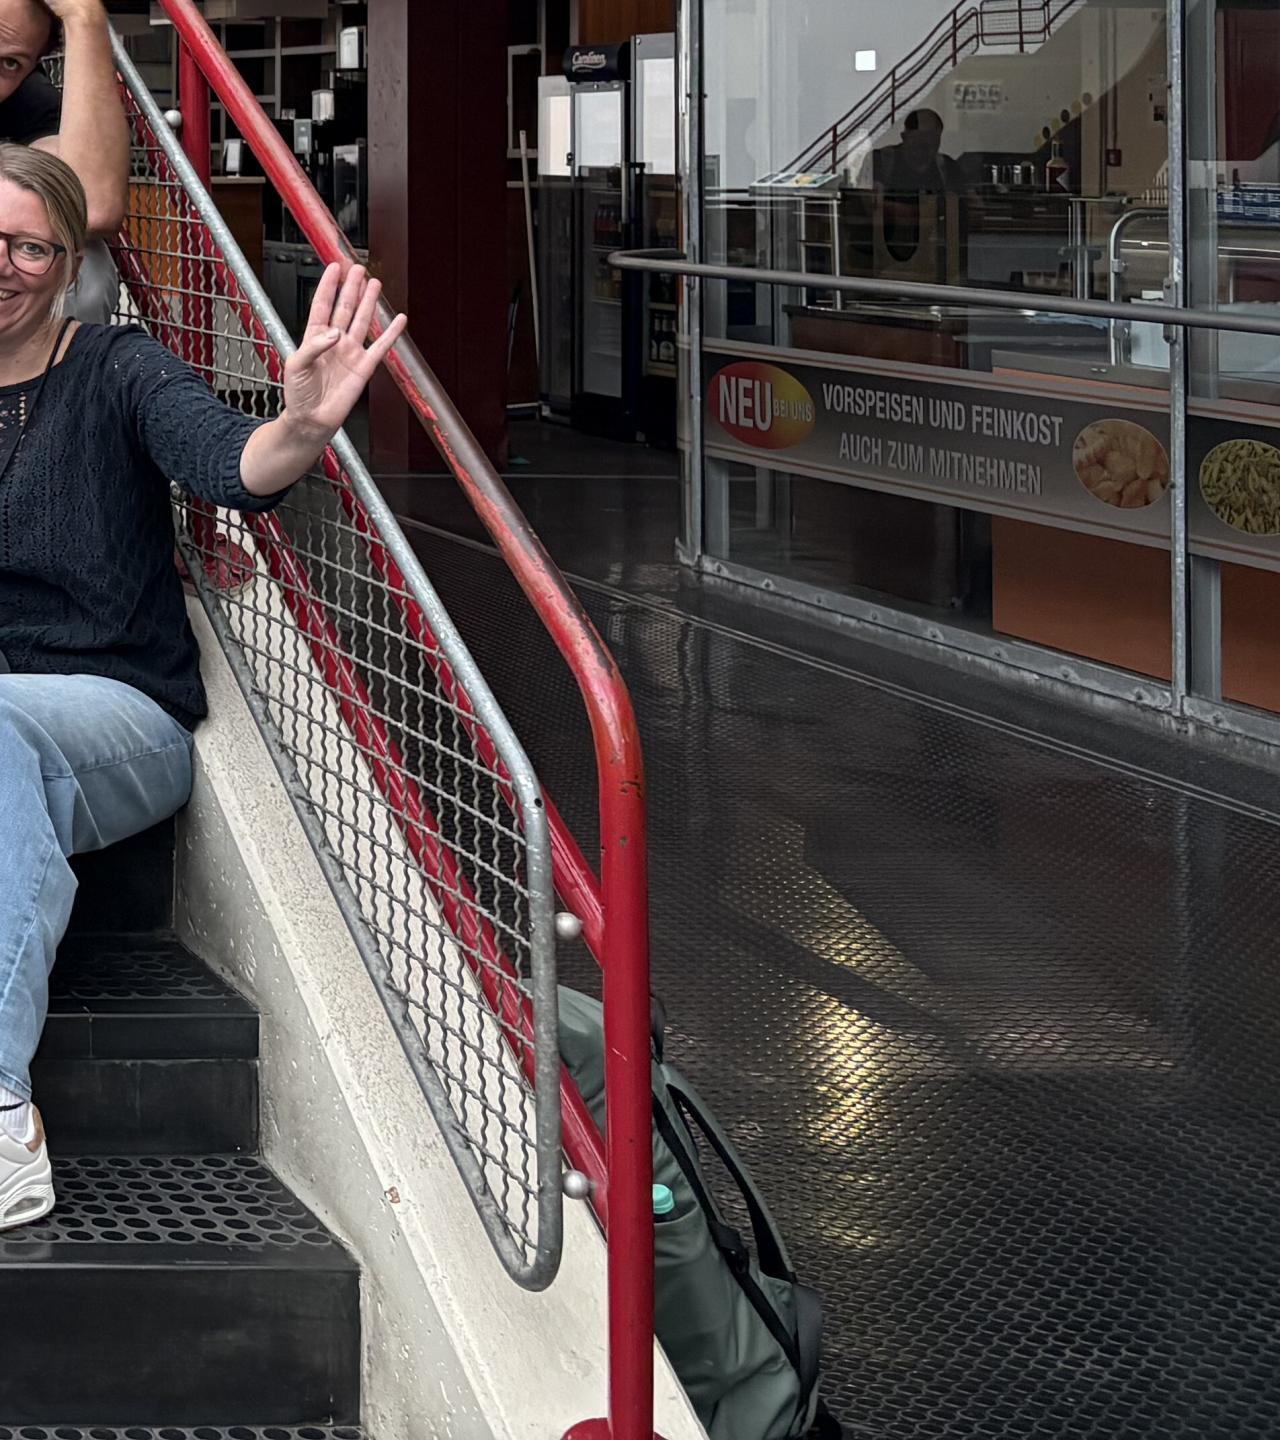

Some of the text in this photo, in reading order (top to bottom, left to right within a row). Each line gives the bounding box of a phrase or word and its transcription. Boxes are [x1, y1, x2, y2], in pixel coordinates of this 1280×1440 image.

[718, 374, 813, 432] NEU BEI UNS
[822, 383, 1063, 446] VORSPEISEN UND FEINKOST
[840, 433, 1042, 496] AUCH ZUM MITNEHMEN
